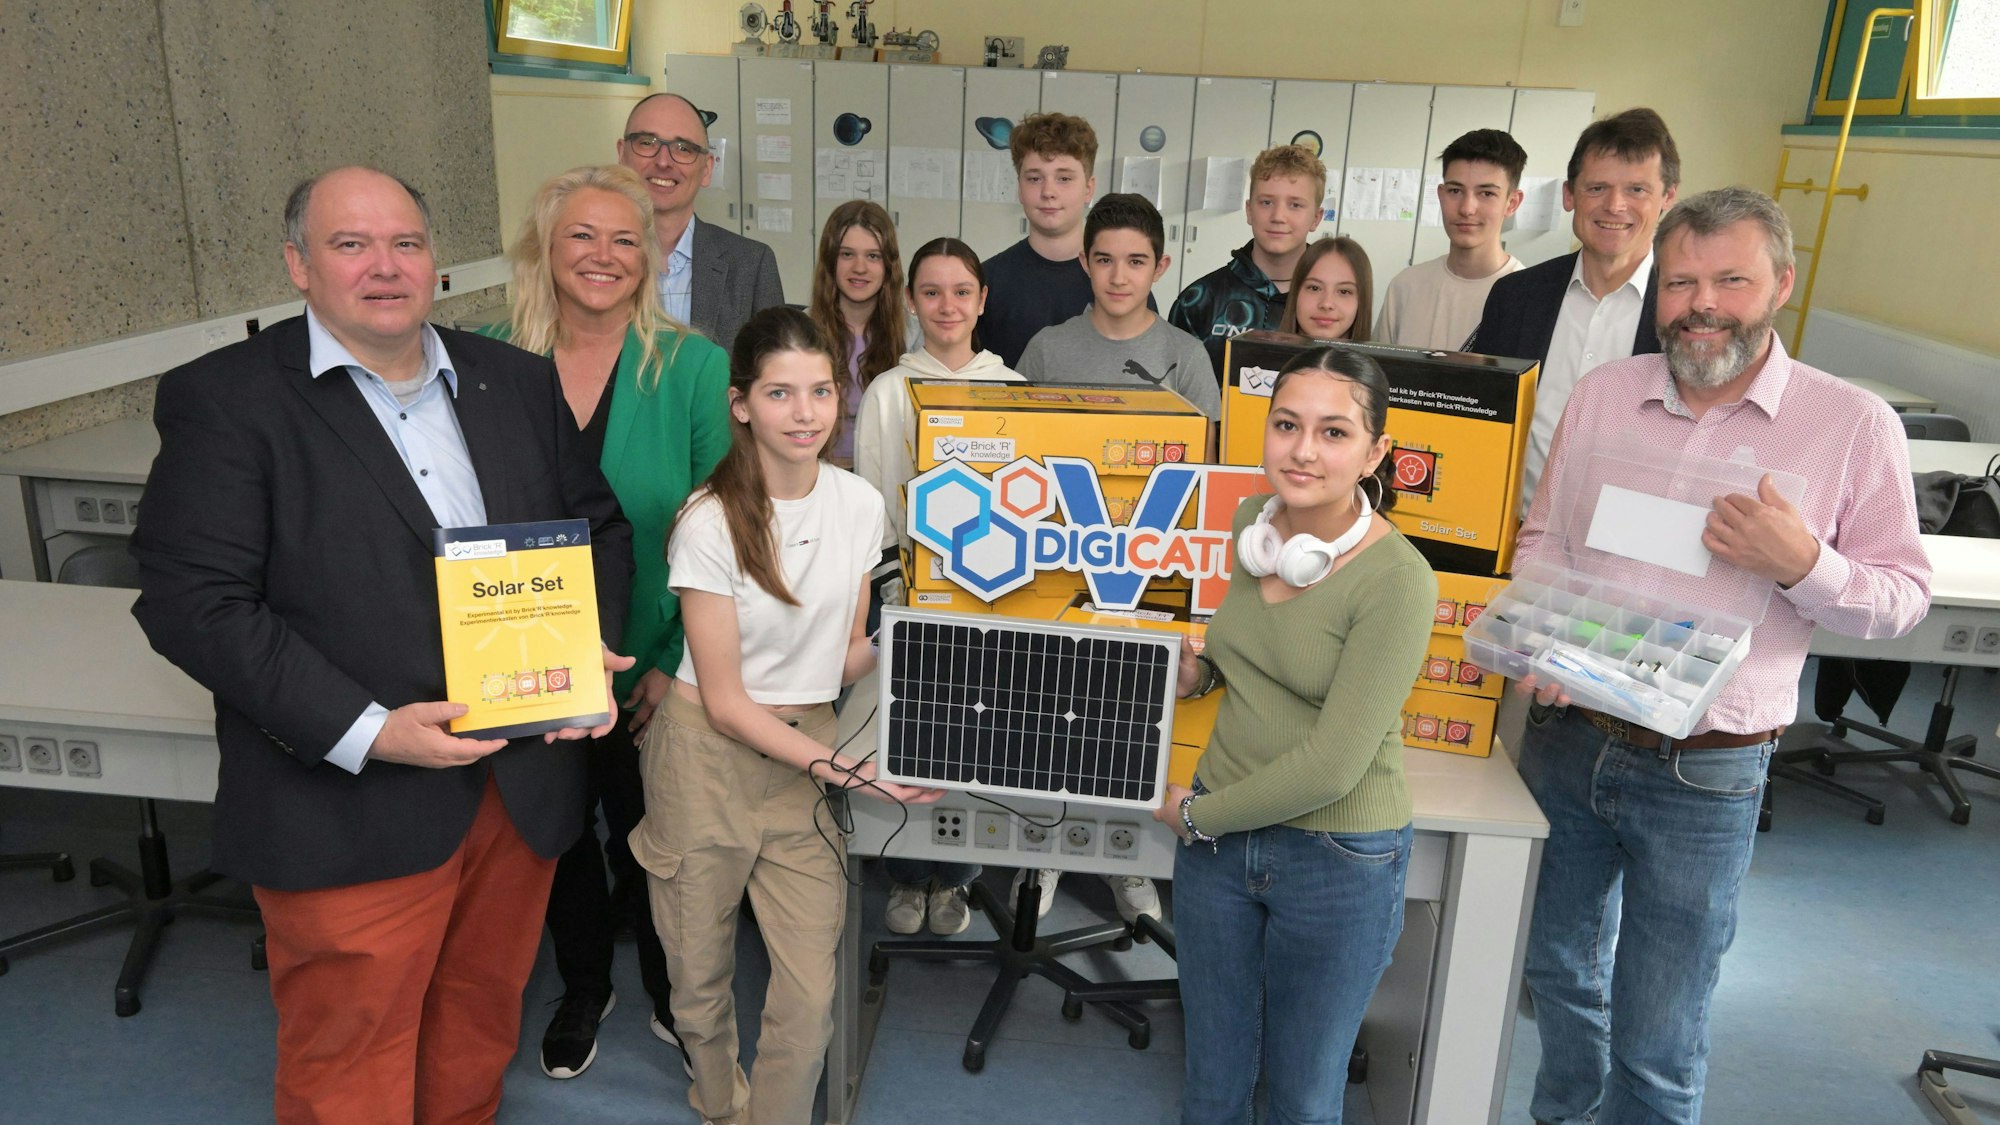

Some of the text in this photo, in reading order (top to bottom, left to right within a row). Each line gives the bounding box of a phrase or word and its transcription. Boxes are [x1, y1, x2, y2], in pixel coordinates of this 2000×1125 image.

[1211, 323, 1253, 337] O'N
[1399, 387, 1408, 395] kit
[1409, 389, 1417, 397] by
[1388, 395, 1422, 406] tierkasten
[995, 416, 1008, 436] 2
[970, 440, 996, 451] Brick
[970, 451, 1011, 460] knowledge
[1420, 519, 1478, 540] Solar Set
[473, 543, 492, 551] Brick
[472, 576, 564, 598] Solar Set
[467, 609, 504, 619] Experimental
[460, 615, 517, 626] Experimentierkasten
